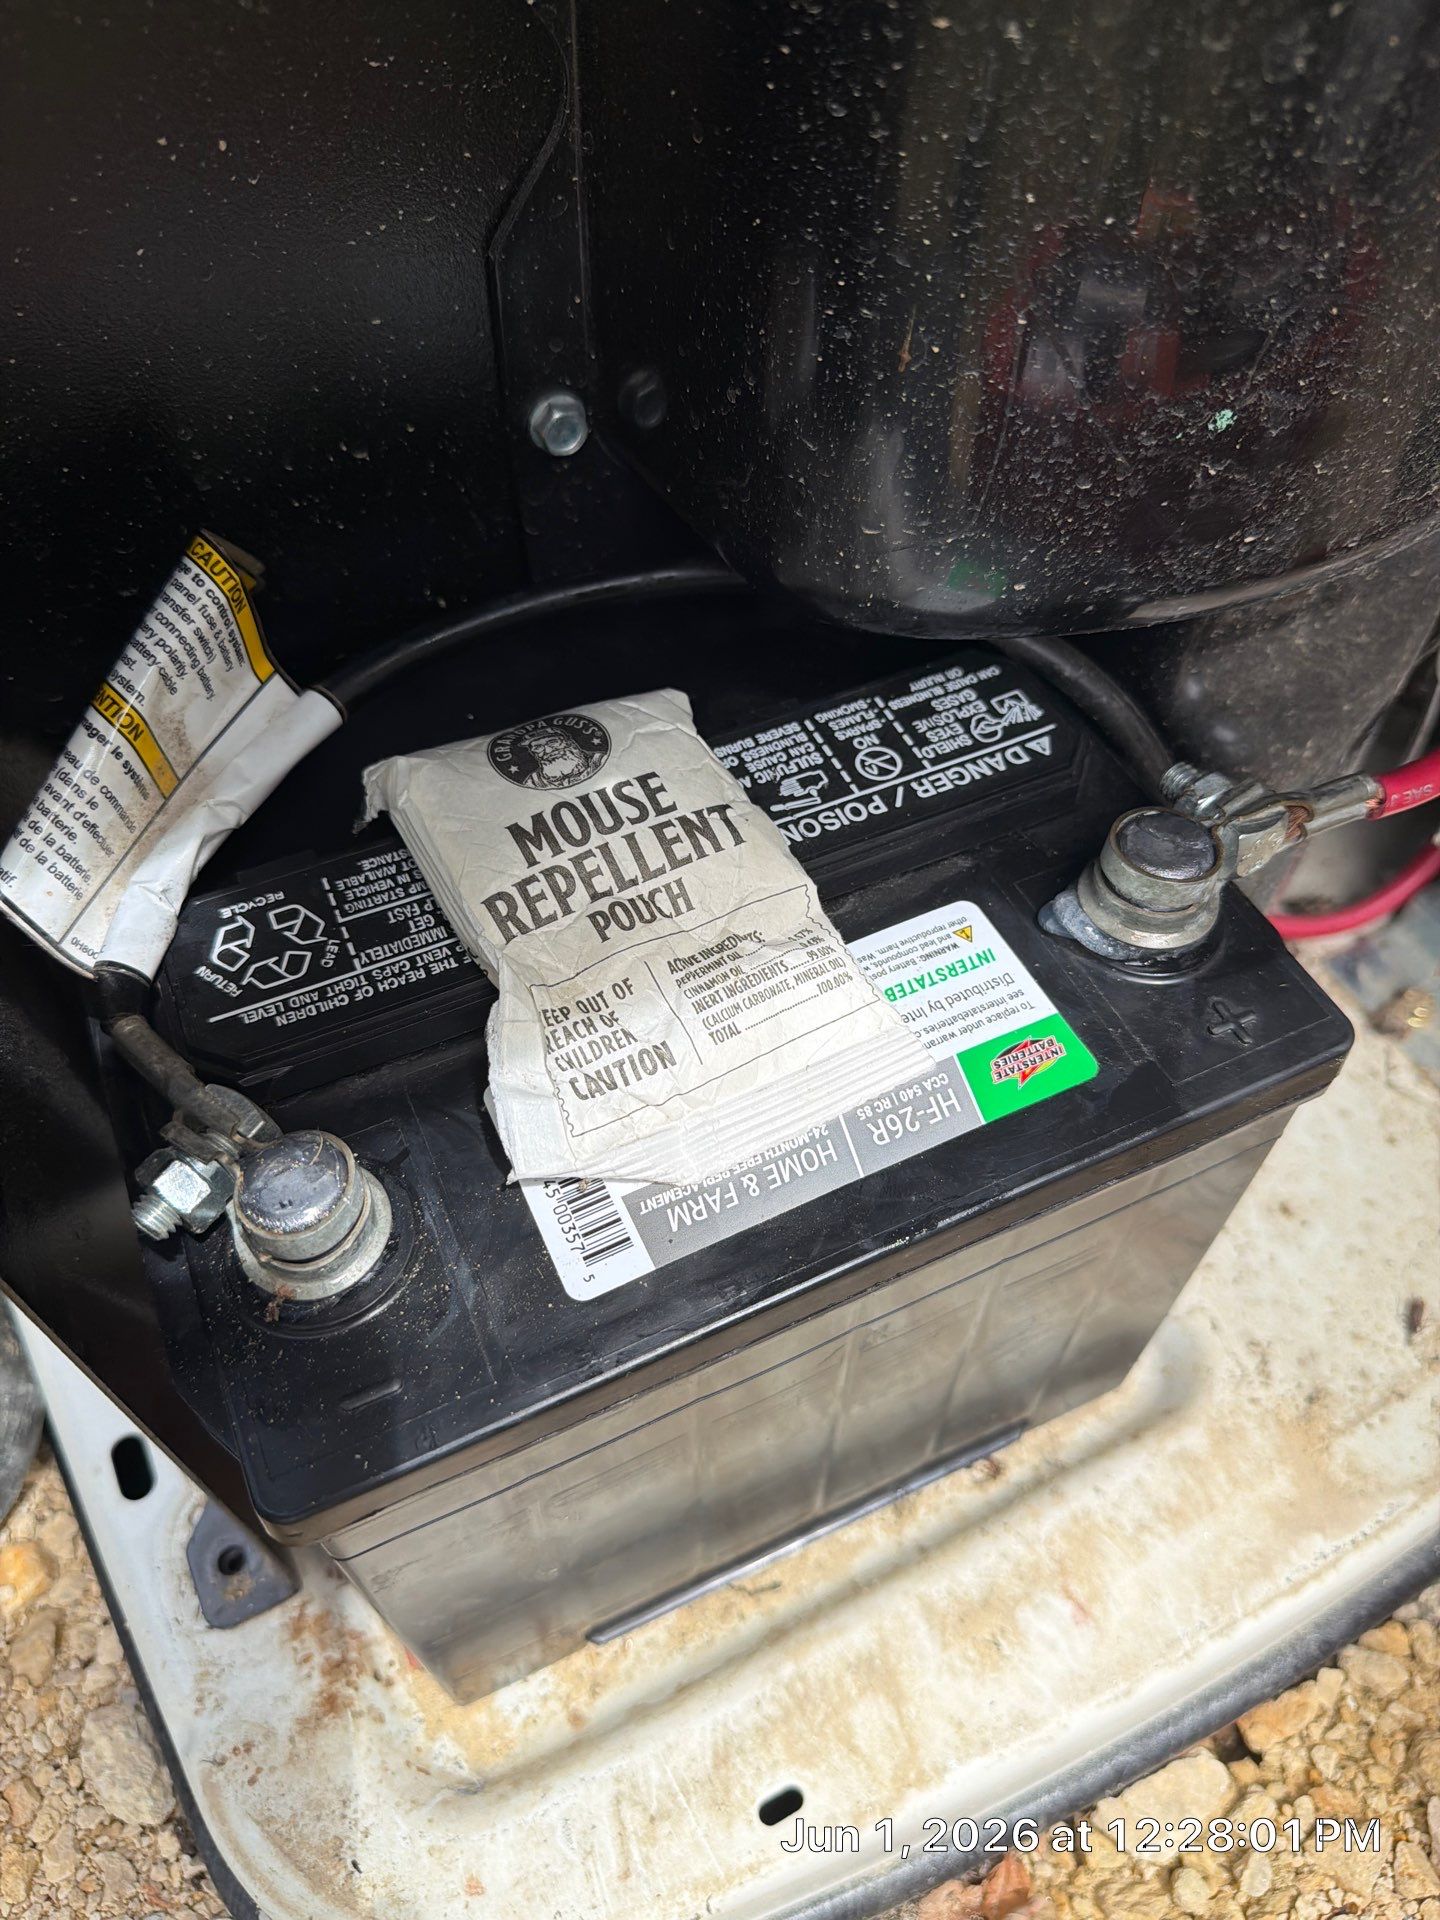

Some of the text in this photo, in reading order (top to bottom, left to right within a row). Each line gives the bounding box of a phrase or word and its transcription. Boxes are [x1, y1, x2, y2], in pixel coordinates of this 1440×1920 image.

[171, 578, 202, 606] panel
[190, 542, 247, 615] CAUTION
[191, 573, 206, 588] to
[205, 589, 234, 633] control
[198, 604, 218, 631] fuse
[194, 626, 216, 665] switch)
[213, 629, 223, 641] &
[120, 653, 137, 672] ast.
[131, 639, 161, 667] attery
[158, 666, 178, 696] cable
[155, 612, 202, 670] connecting
[196, 665, 216, 703] battery.
[216, 638, 235, 673] battery
[930, 687, 978, 712] GASES
[944, 674, 979, 694] CAUSE
[97, 688, 145, 742] NTION
[911, 699, 988, 733] EXPLOSIVE
[713, 721, 802, 759] SEVERE BURNS
[740, 731, 809, 762] BLINDNESS
[852, 733, 881, 750] NO
[921, 732, 974, 759] SHIELD
[925, 721, 966, 743] EYES
[111, 745, 124, 761] le
[744, 750, 788, 774] CAUSE
[788, 741, 816, 759] CAN
[63, 748, 85, 770] eau
[83, 769, 101, 786] de
[910, 745, 1032, 799] DANGER
[44, 783, 76, 812] avant
[55, 769, 100, 811] (dans le
[28, 818, 44, 836] de
[43, 833, 57, 849] la
[504, 771, 678, 870] MOUSE
[780, 794, 889, 847] POISON
[19, 837, 84, 900] de la batterie
[356, 849, 410, 871] STANCE.
[401, 859, 418, 872] OT
[481, 803, 747, 945] REPELLENT
[0, 865, 18, 889] atif.
[334, 867, 397, 891] AVAILABLE
[344, 880, 395, 901] VEHICLE
[396, 873, 411, 885] IN
[218, 890, 286, 919] RECYCLE
[343, 886, 406, 914] STARTING
[388, 903, 421, 924] FAST
[586, 877, 696, 944] POUCH
[408, 914, 436, 934] GET
[899, 924, 947, 944] reproductive
[947, 916, 968, 929] other
[320, 938, 341, 968] LEAD
[357, 925, 449, 965] IMMEDIATELY
[414, 946, 451, 968] VENT
[870, 933, 953, 967] and lead compounds,
[875, 942, 901, 955] harm.
[888, 942, 960, 973] WARNING: Battery
[193, 965, 244, 998] RETURN
[371, 959, 411, 981] CAPS
[377, 968, 427, 993] REACH
[429, 957, 459, 975] THE
[675, 956, 728, 989] PEPPERMINT
[683, 970, 731, 999] CINNAMON
[729, 964, 748, 977] OIL
[884, 948, 997, 1002] INTERSTATEB
[289, 990, 321, 1009] AND
[326, 974, 370, 998] TIGHT
[353, 985, 374, 1003] OF
[690, 989, 725, 1015] INERT
[724, 960, 790, 998] INGREDIENTS
[701, 957, 848, 1031] (CALCIUM CARBONATE, MINERAL OIL)
[946, 971, 1016, 1009] Distributed
[1008, 988, 1026, 1002] see
[238, 1001, 286, 1025] LEVEL
[275, 994, 350, 1027] CHILDREN
[541, 977, 634, 1027] EEP OUT OF
[708, 1021, 742, 1046] TOTAL
[816, 971, 854, 996] 100.00%
[929, 998, 947, 1015] by
[923, 1000, 1037, 1050] To replace under warran
[554, 1027, 639, 1072] CHILDREN
[993, 1037, 1056, 1070] BATTERIES
[994, 1044, 1064, 1081] INTERSTATE
[568, 1040, 678, 1101] CAUTION
[856, 1072, 949, 1121] CCA 540 RC 85
[866, 1088, 962, 1146] HF-26R
[667, 1139, 839, 1233] HOME & FARM
[553, 1203, 586, 1252] 00357
[583, 1273, 596, 1283] 5
